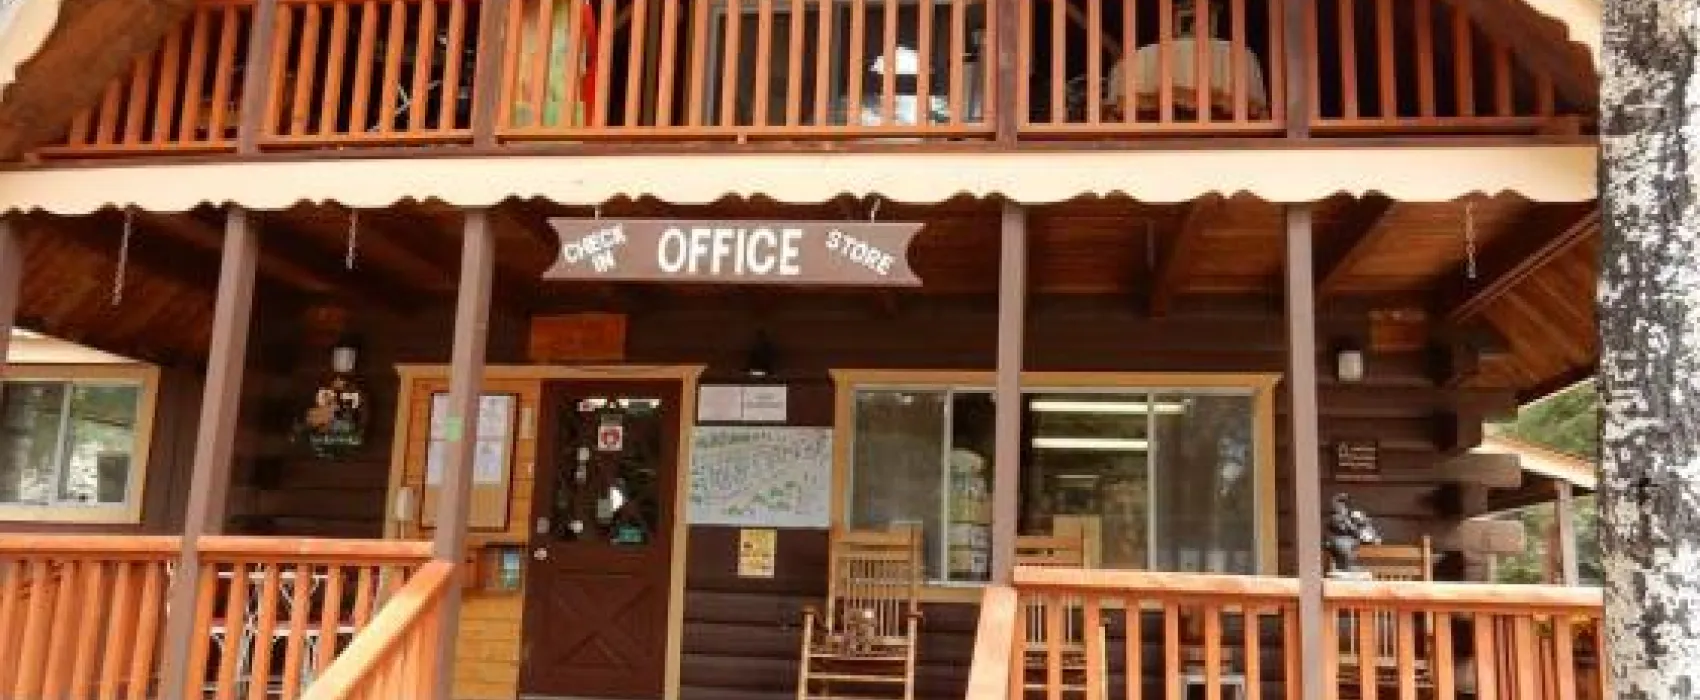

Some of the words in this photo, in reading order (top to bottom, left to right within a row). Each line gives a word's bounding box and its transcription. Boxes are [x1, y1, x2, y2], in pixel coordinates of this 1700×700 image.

[563, 224, 626, 263] CHECK
[591, 252, 615, 273] IN
[658, 228, 802, 275] OFFICE
[826, 229, 895, 276] STORE
